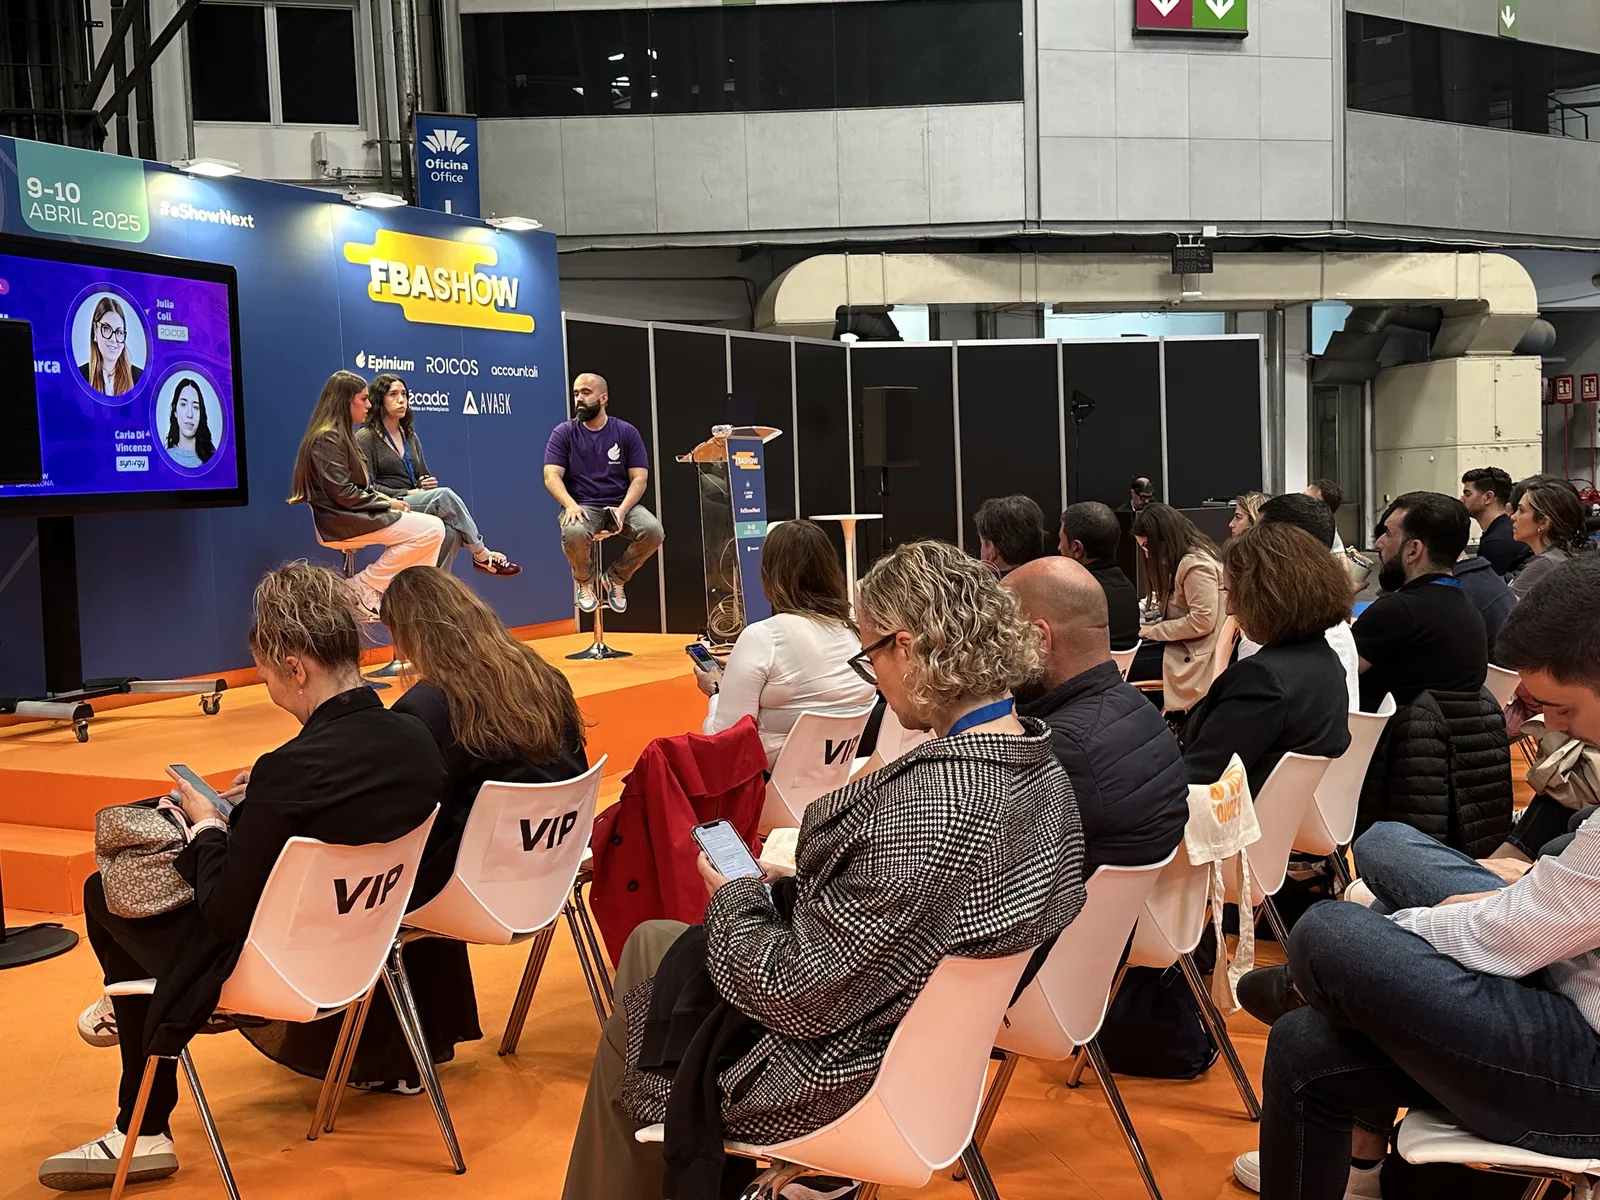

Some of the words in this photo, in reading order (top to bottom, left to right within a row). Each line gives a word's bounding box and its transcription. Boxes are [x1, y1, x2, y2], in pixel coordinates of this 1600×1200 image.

[425, 159, 468, 170] Oficina
[431, 171, 464, 183] Office
[26, 177, 81, 204] 9-10
[29, 202, 88, 226] ABRIL
[92, 210, 142, 232] 2025
[159, 200, 255, 228] #eShowNext
[370, 258, 519, 308] FBASHOW
[156, 299, 175, 309] Julia
[156, 311, 172, 322] Coll
[160, 328, 186, 339] ROICOS
[34, 360, 61, 374] rca
[368, 355, 415, 372] Epinium
[425, 356, 479, 376] ROICOS
[491, 365, 539, 378] accountali
[408, 389, 450, 406] écada
[480, 392, 512, 415] AVASK
[115, 430, 135, 440] Carla
[136, 430, 145, 440] Di
[115, 443, 152, 453] Vincenzo
[825, 734, 860, 765] VIP
[519, 810, 578, 852] VIP
[333, 863, 404, 915] VIP
